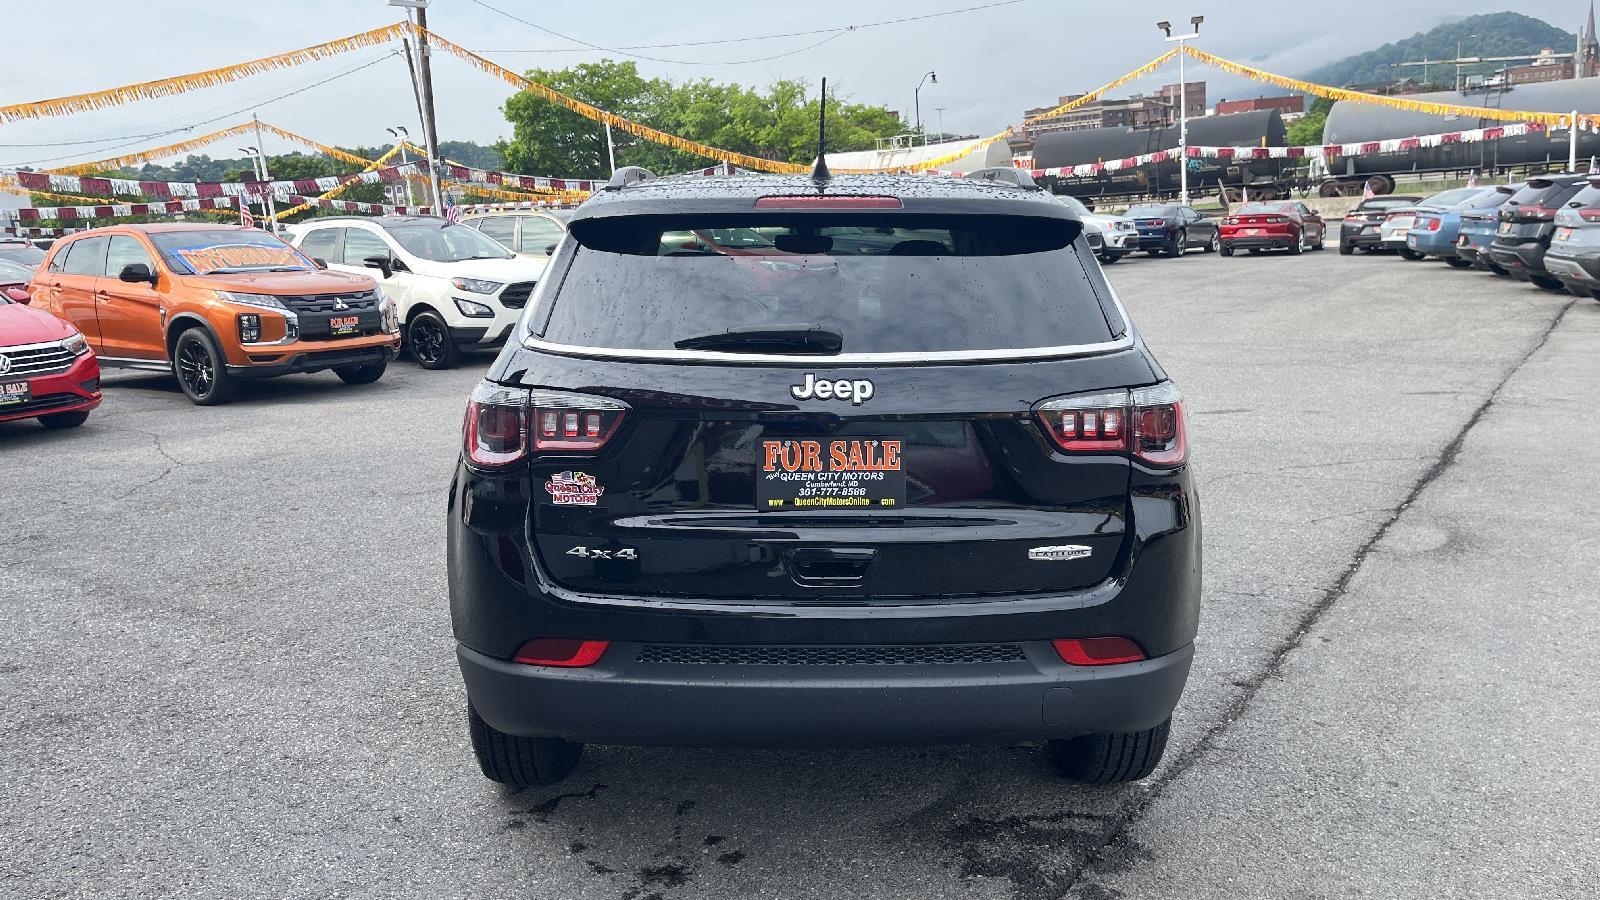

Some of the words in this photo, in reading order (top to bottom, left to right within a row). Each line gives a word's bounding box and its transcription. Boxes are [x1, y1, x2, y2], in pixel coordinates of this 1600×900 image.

[791, 373, 874, 405] Jeep
[763, 440, 823, 472] FOR
[830, 440, 901, 472] SALE
[780, 472, 815, 482] QUEEN
[817, 472, 841, 480] CITY
[841, 472, 885, 480] MOTORS
[553, 494, 597, 503] MOTORS
[566, 546, 637, 560] 4x4
